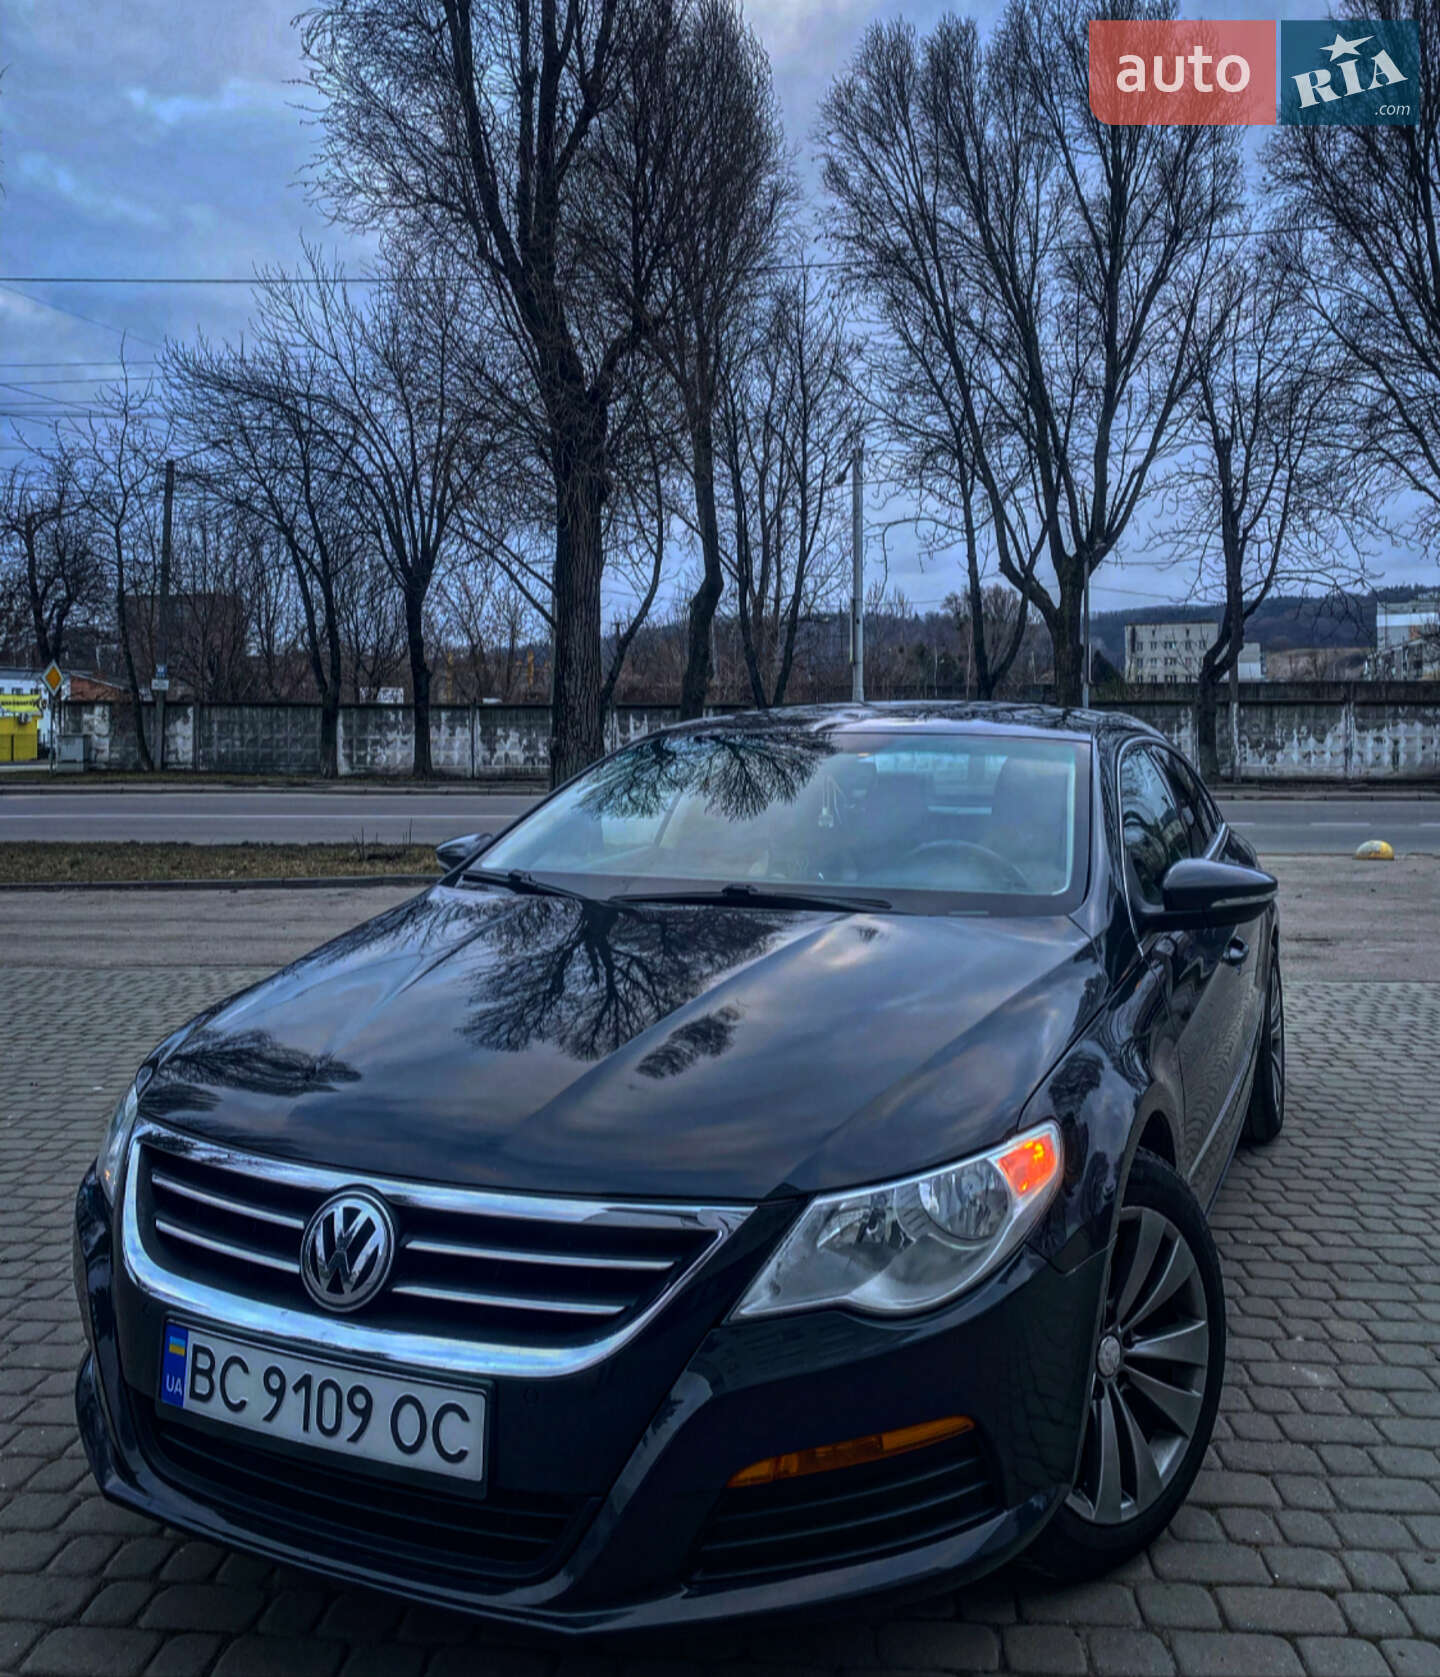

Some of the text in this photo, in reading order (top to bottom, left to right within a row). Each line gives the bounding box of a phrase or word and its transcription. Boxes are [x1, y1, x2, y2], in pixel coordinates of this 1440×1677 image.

[308, 1199, 387, 1303] VW
[166, 1373, 183, 1396] UA
[189, 1343, 471, 1464] BC 9109 OC
